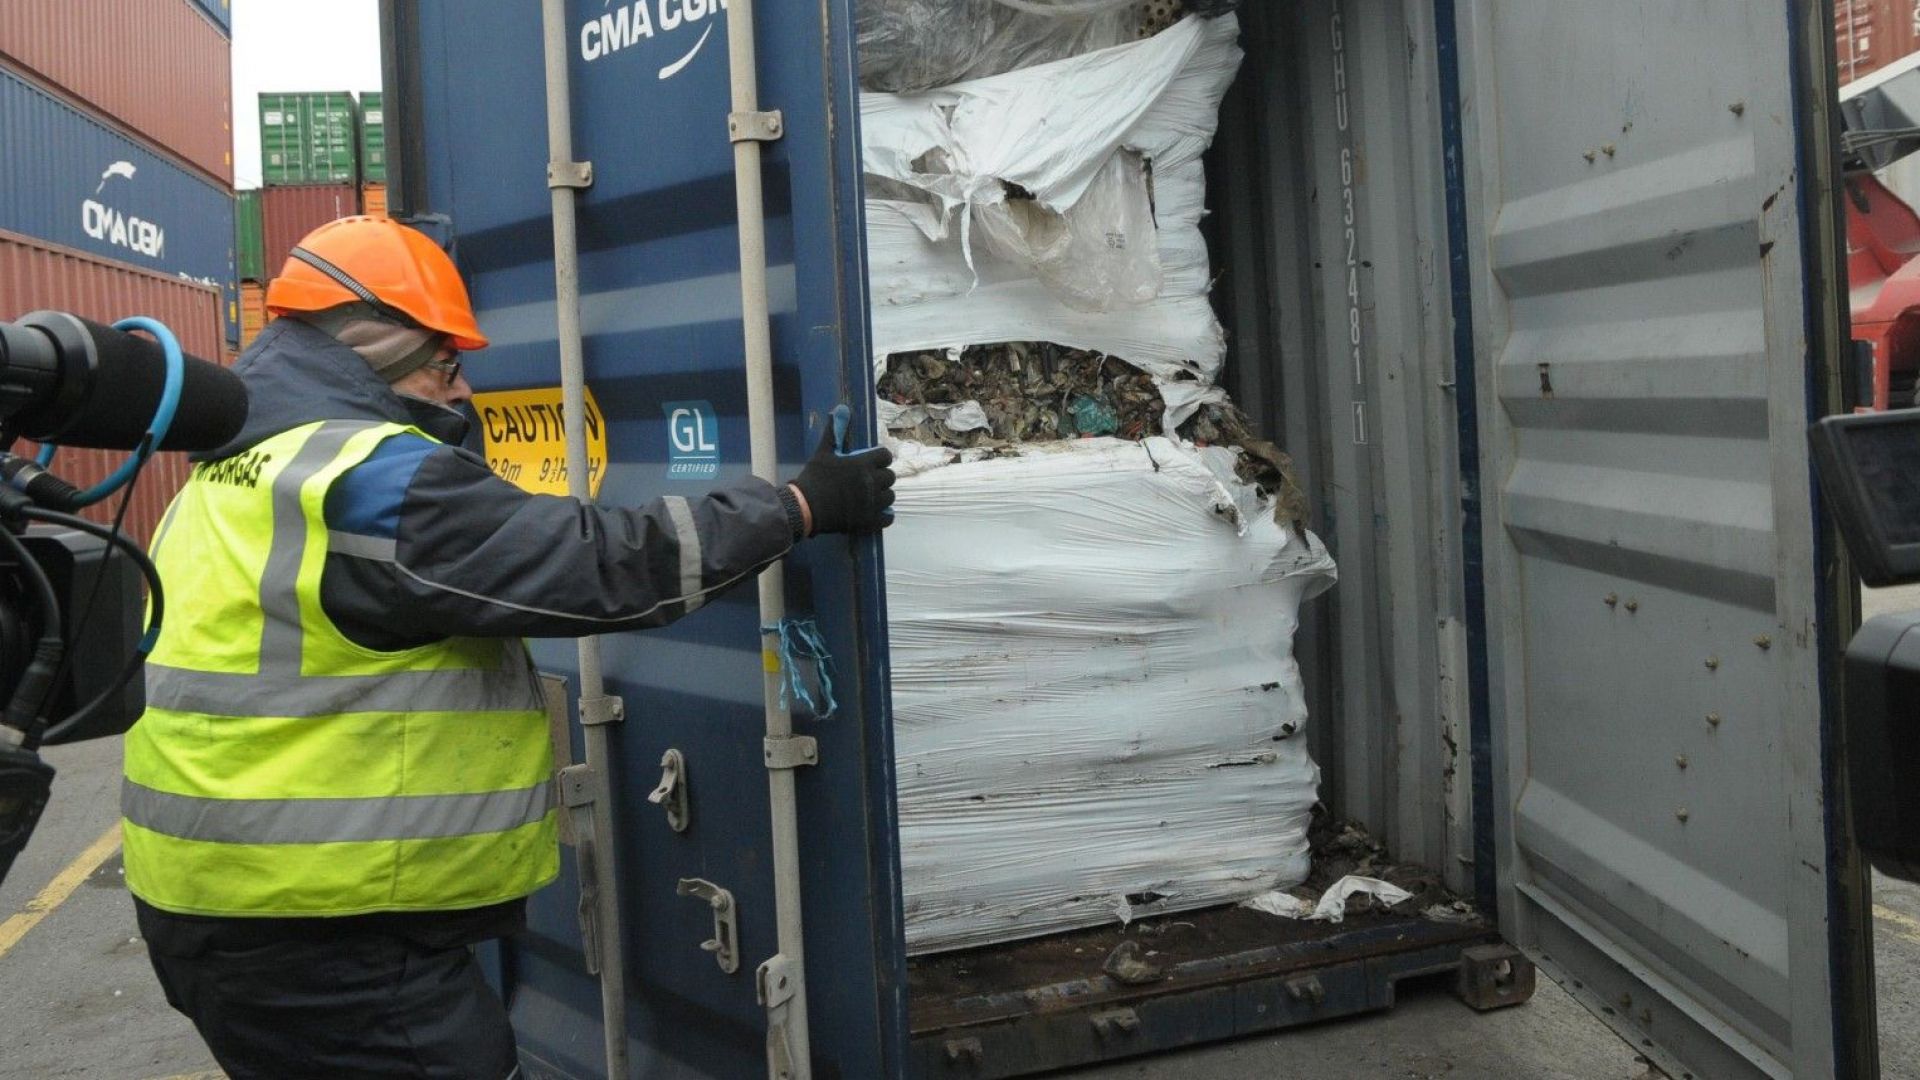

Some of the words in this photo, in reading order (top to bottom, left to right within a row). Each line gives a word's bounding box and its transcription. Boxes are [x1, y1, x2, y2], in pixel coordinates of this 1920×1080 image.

[580, 0, 654, 61] CMA
[1331, 0, 1348, 131] GHU
[1340, 148, 1362, 385] 632481
[1354, 403, 1366, 442] 1
[671, 408, 716, 452] GL
[671, 463, 716, 473] CERTIFIED
